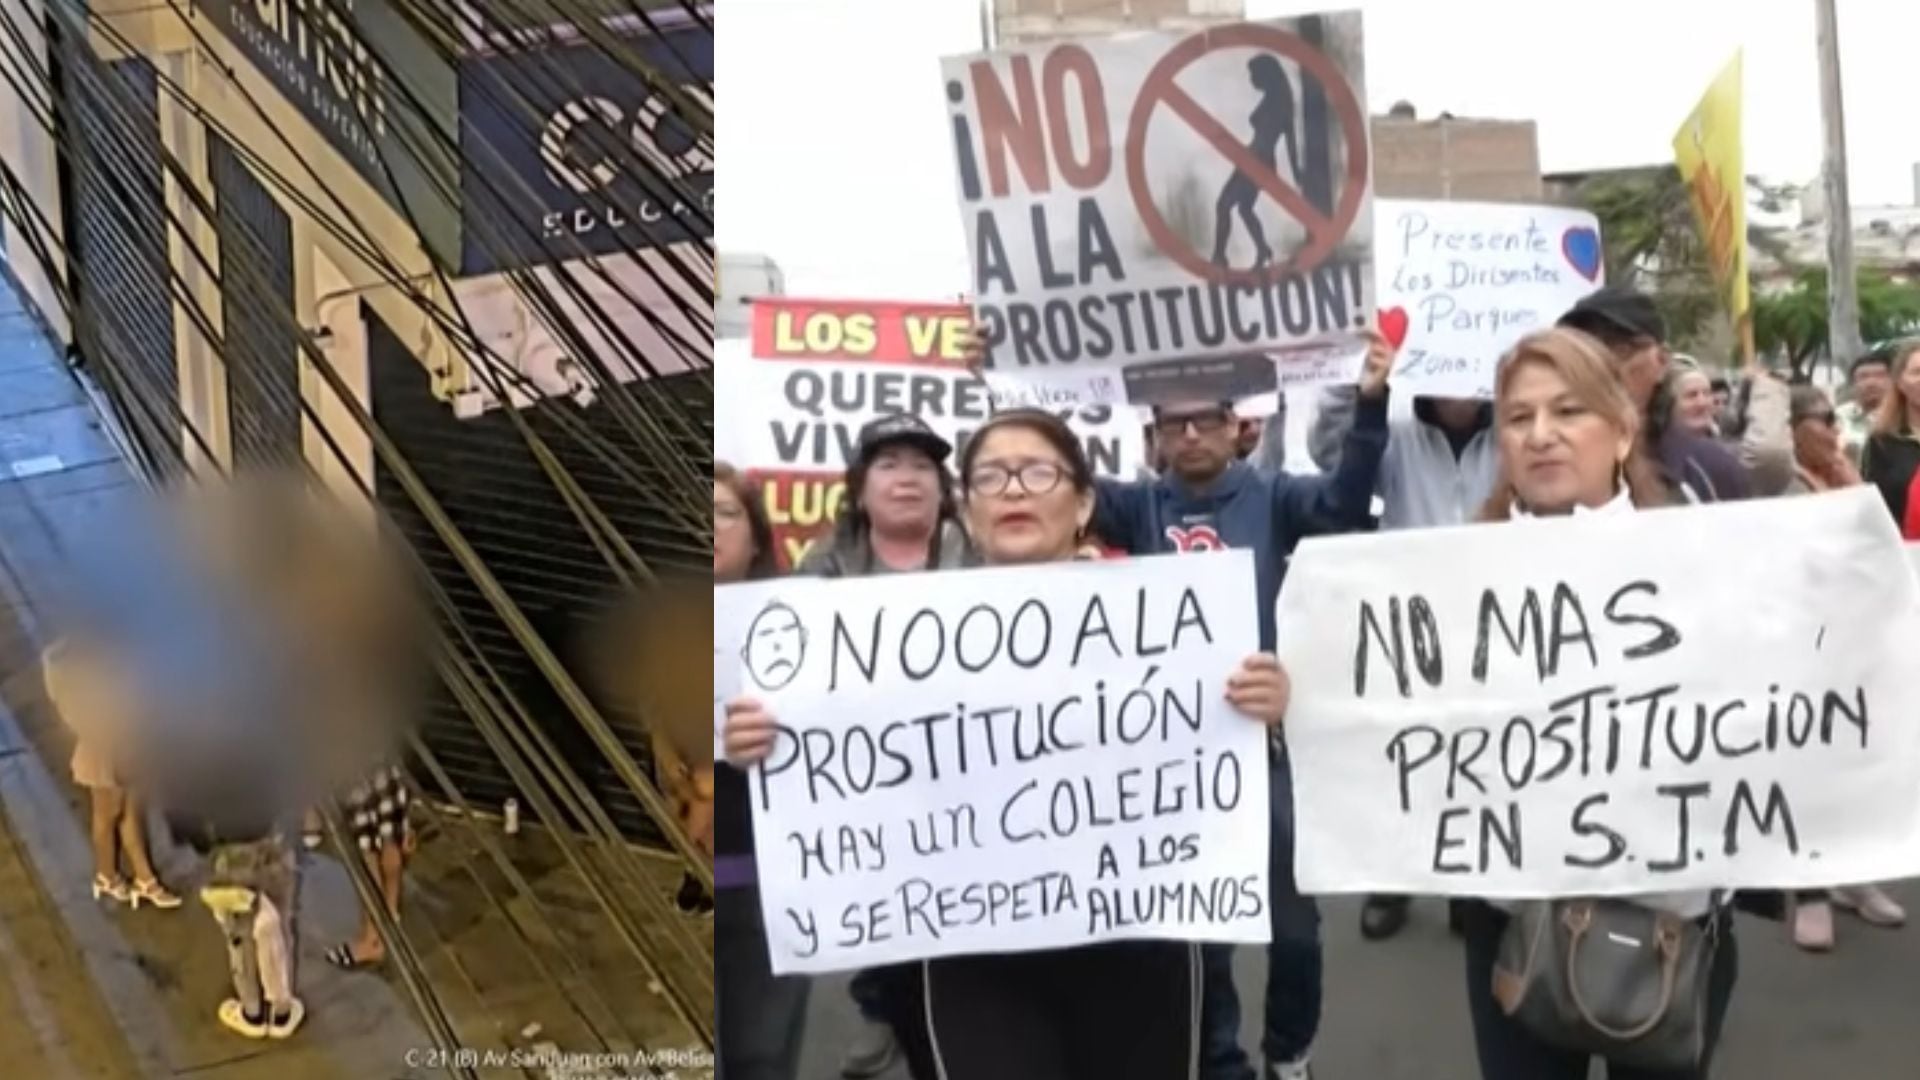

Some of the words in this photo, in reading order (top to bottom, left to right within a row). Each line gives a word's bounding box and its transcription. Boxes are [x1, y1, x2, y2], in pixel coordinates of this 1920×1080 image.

[946, 42, 1113, 201] ¡NO
[976, 209, 1018, 295] A
[1030, 197, 1126, 290] LA
[1397, 211, 1549, 257] Presente
[775, 310, 878, 355] LOS
[905, 315, 974, 360] VE
[827, 598, 1052, 692] NOOO
[1070, 593, 1122, 667] A
[1135, 586, 1214, 657] LA
[1353, 594, 1444, 698] NO
[1471, 579, 1682, 683] MAS
[1096, 843, 1120, 881] A
[1138, 833, 1201, 870] LOS
[1431, 801, 1522, 875] EN
[837, 899, 895, 949] SE
[895, 872, 1080, 941] RESPETA
[1086, 875, 1263, 937] ALUMNOS
